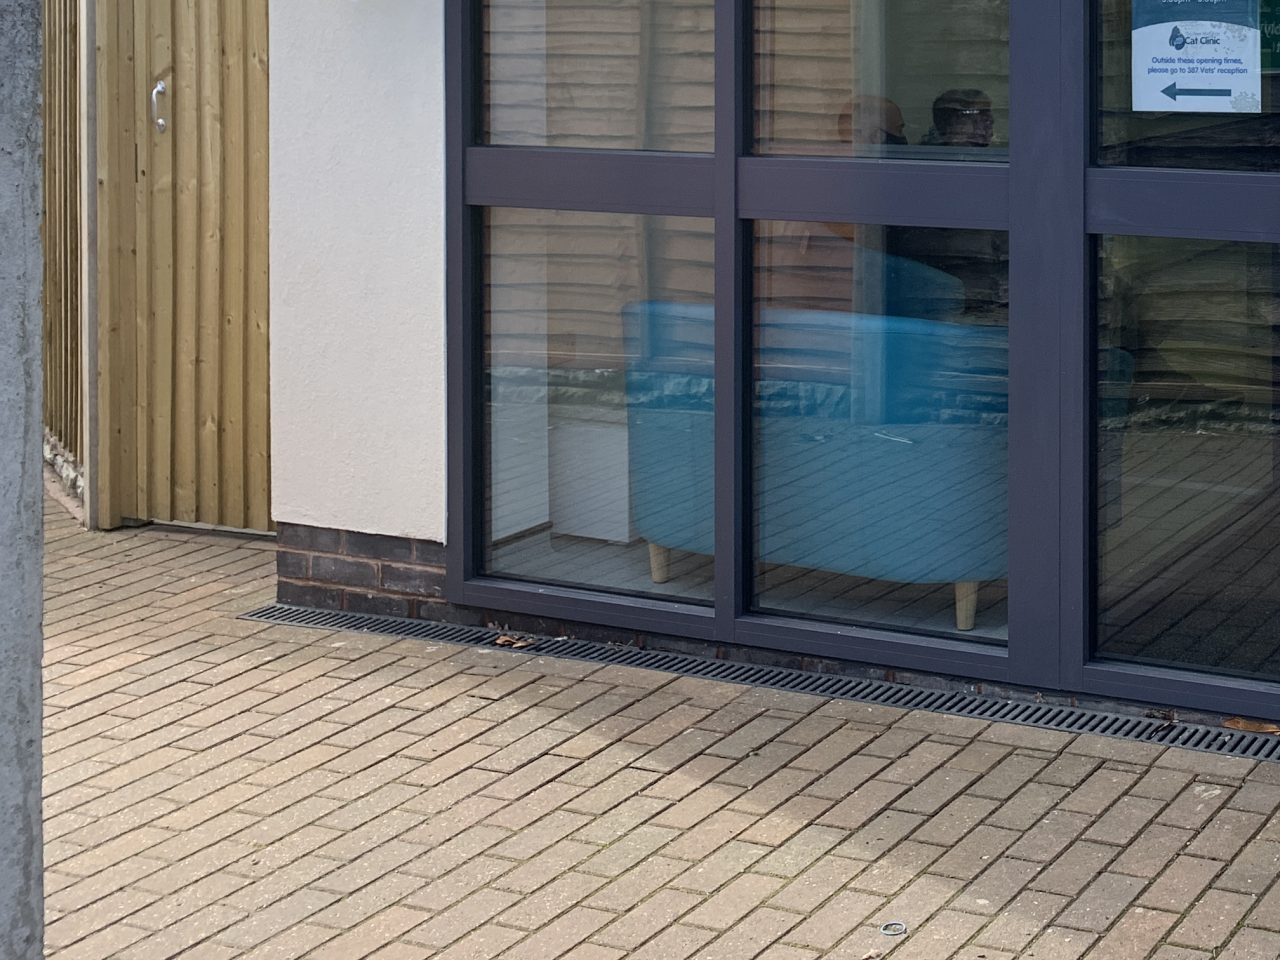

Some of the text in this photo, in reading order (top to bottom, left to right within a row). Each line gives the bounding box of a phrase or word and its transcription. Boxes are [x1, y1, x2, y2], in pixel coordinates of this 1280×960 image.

[1185, 36, 1221, 45] Cat Clinic
[1151, 56, 1176, 64] Outside
[1177, 56, 1195, 64] these
[1195, 57, 1223, 66] opening
[1147, 66, 1169, 76] please
[1169, 68, 1178, 76] go
[1179, 66, 1186, 74] to
[1217, 66, 1248, 76] reception
